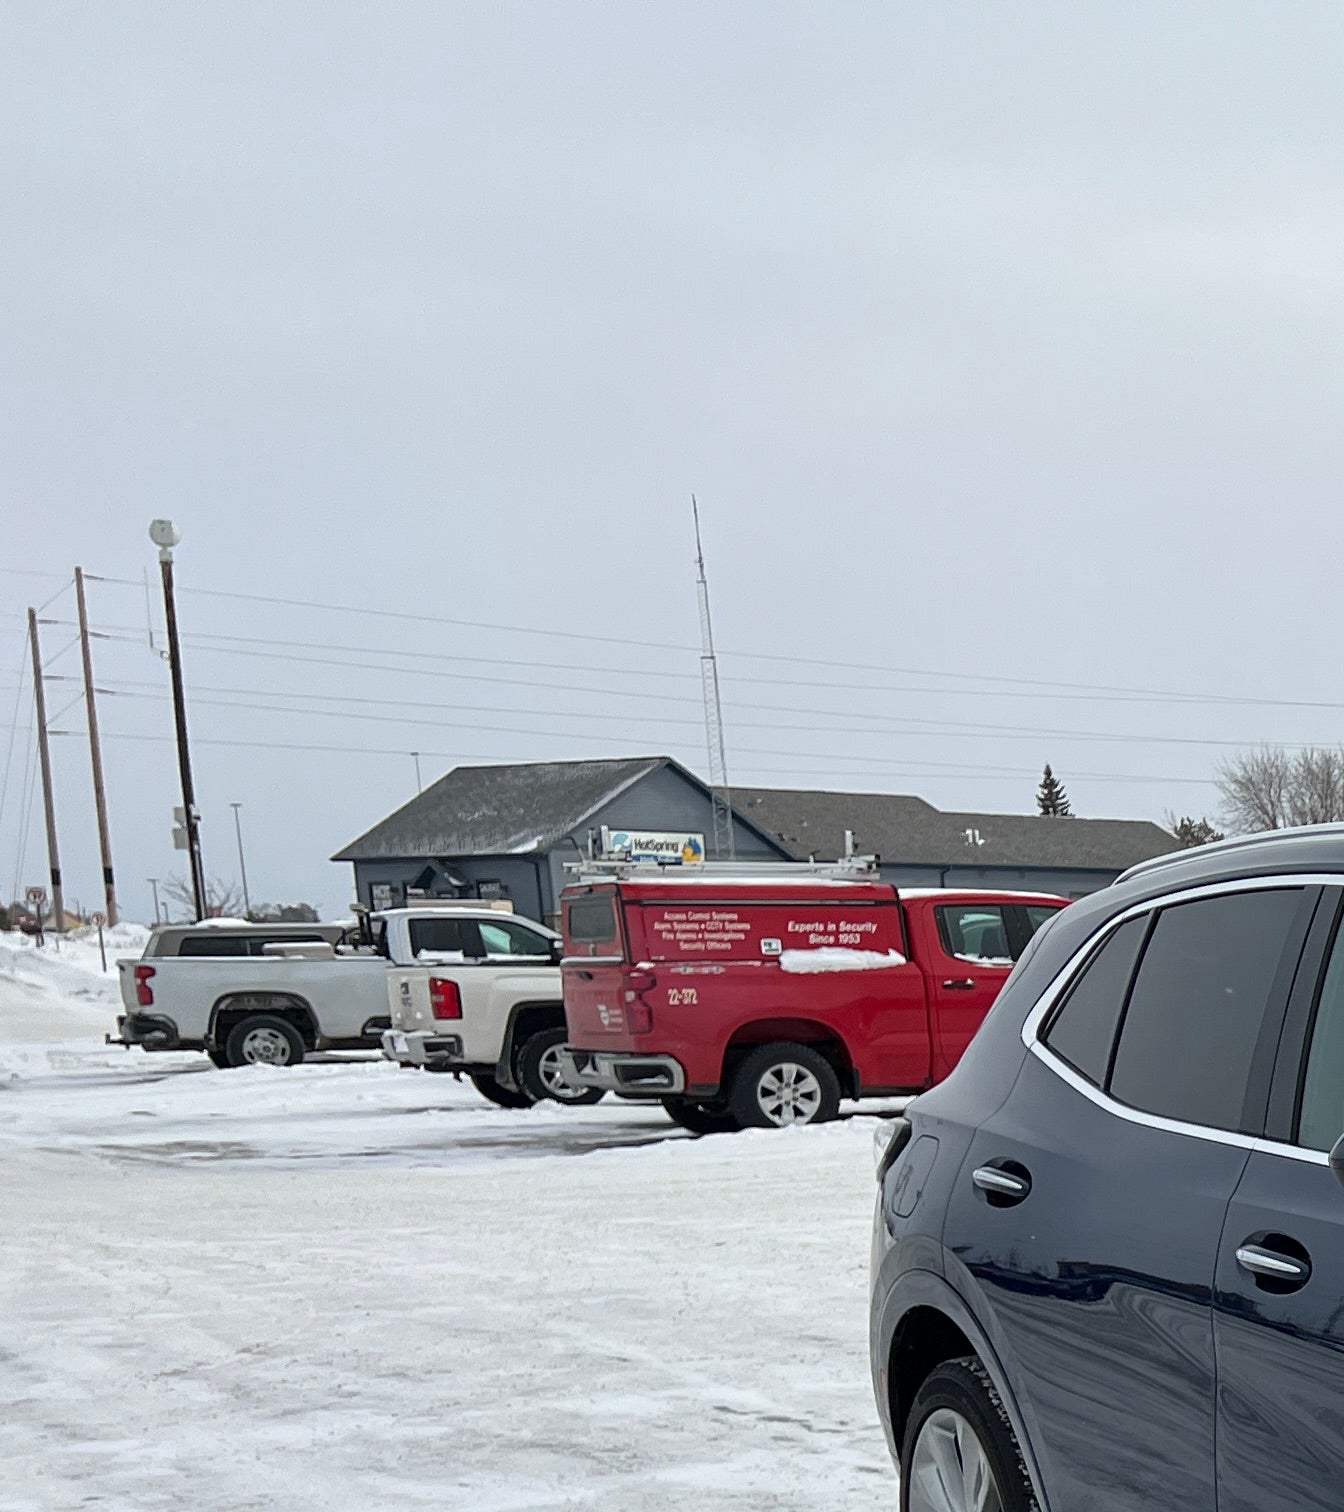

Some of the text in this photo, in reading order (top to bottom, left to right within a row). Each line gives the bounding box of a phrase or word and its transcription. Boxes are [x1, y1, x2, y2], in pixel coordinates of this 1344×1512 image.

[787, 920, 878, 934] Experts in Security
[808, 932, 861, 945] Since 1953
